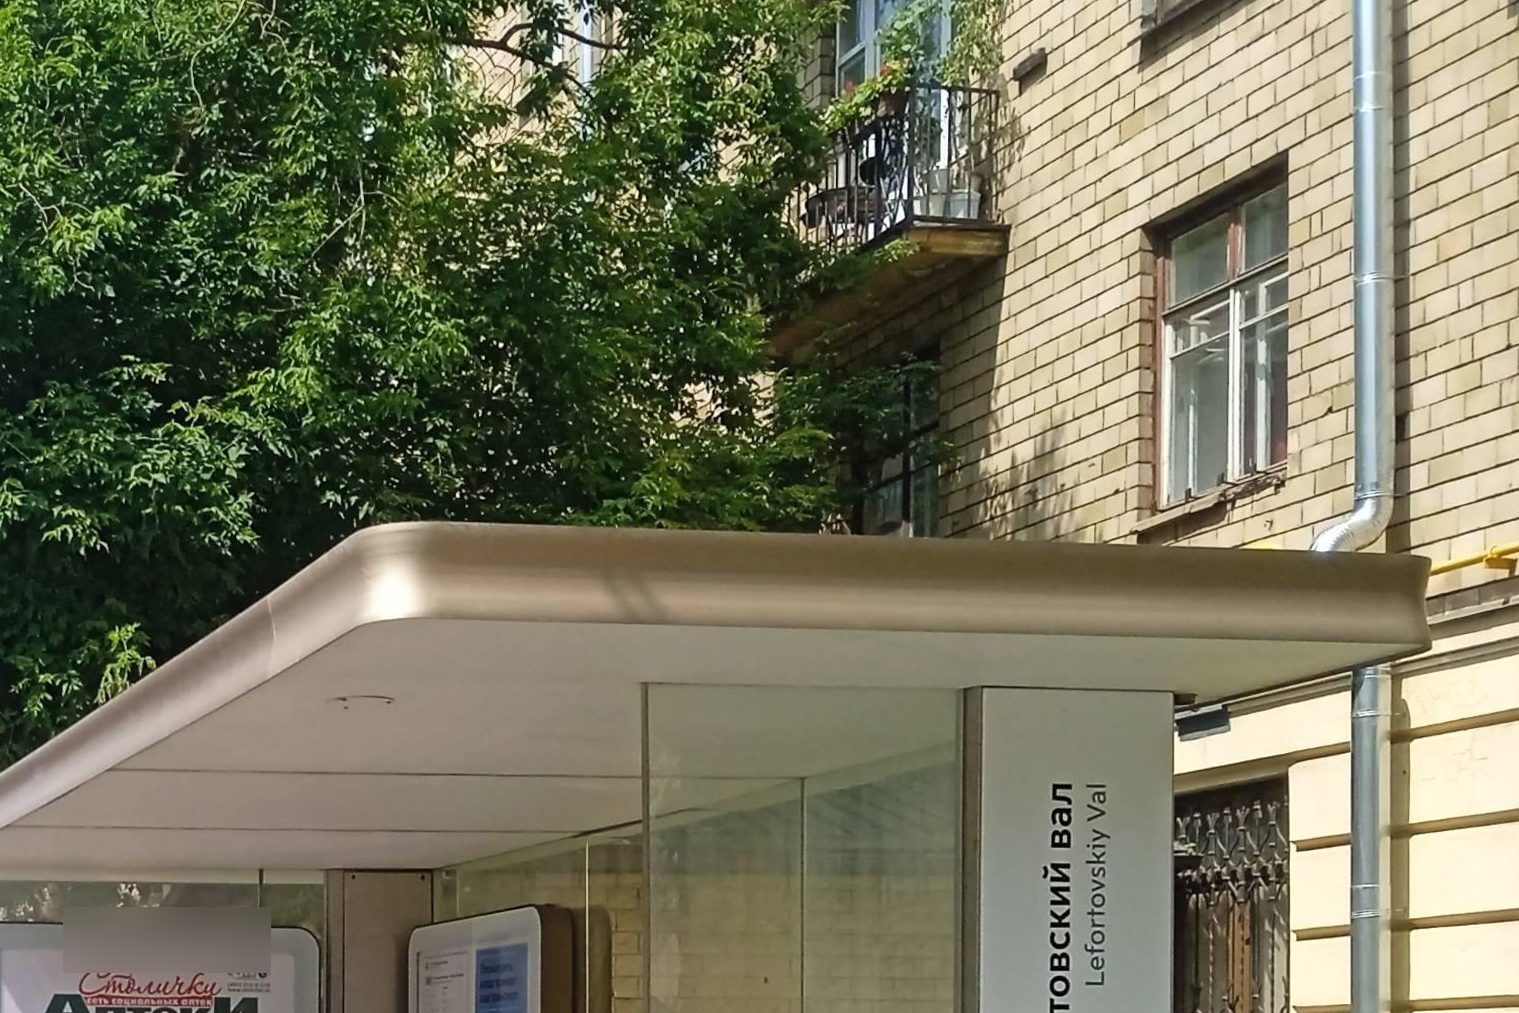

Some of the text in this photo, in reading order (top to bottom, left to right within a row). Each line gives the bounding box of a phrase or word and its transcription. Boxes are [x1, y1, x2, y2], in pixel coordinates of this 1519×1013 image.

[1051, 784, 1073, 849] вал
[1084, 784, 1111, 986] Lefortovskiy Val
